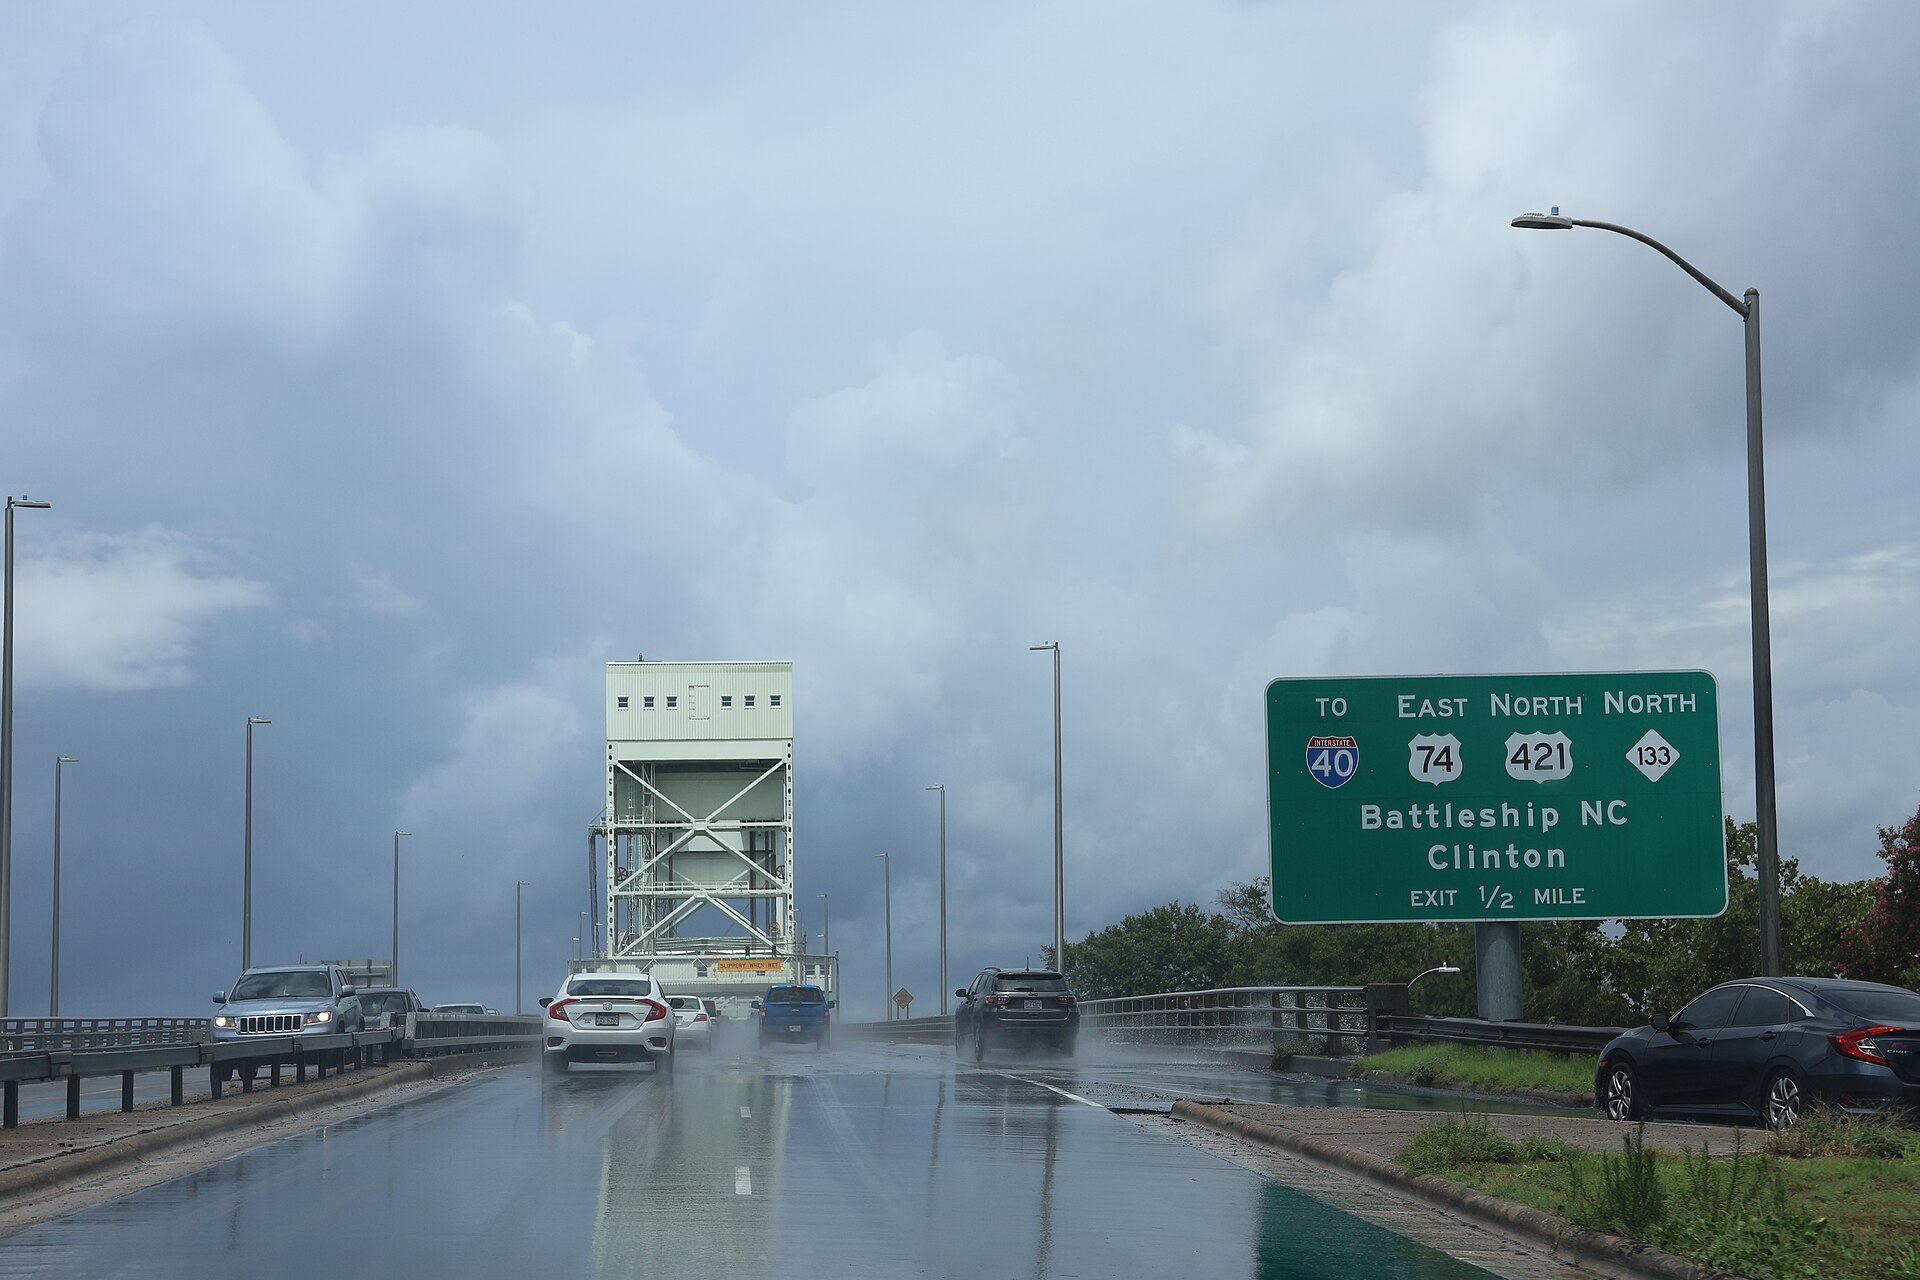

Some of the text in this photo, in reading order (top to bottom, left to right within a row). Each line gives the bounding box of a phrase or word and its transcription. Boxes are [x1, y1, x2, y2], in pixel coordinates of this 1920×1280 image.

[1315, 690, 1697, 718] TO EAST NORTH NORTH
[1314, 739, 1351, 747] INTERSTATE
[1510, 742, 1567, 771] 421
[1636, 746, 1672, 766] 133
[1311, 749, 1355, 778] 40
[1416, 745, 1454, 774] 74
[1360, 800, 1629, 833] Battleship NC
[1427, 843, 1566, 870] Clinton
[1410, 890, 1458, 907] EXIT
[1534, 887, 1586, 905] MILE
